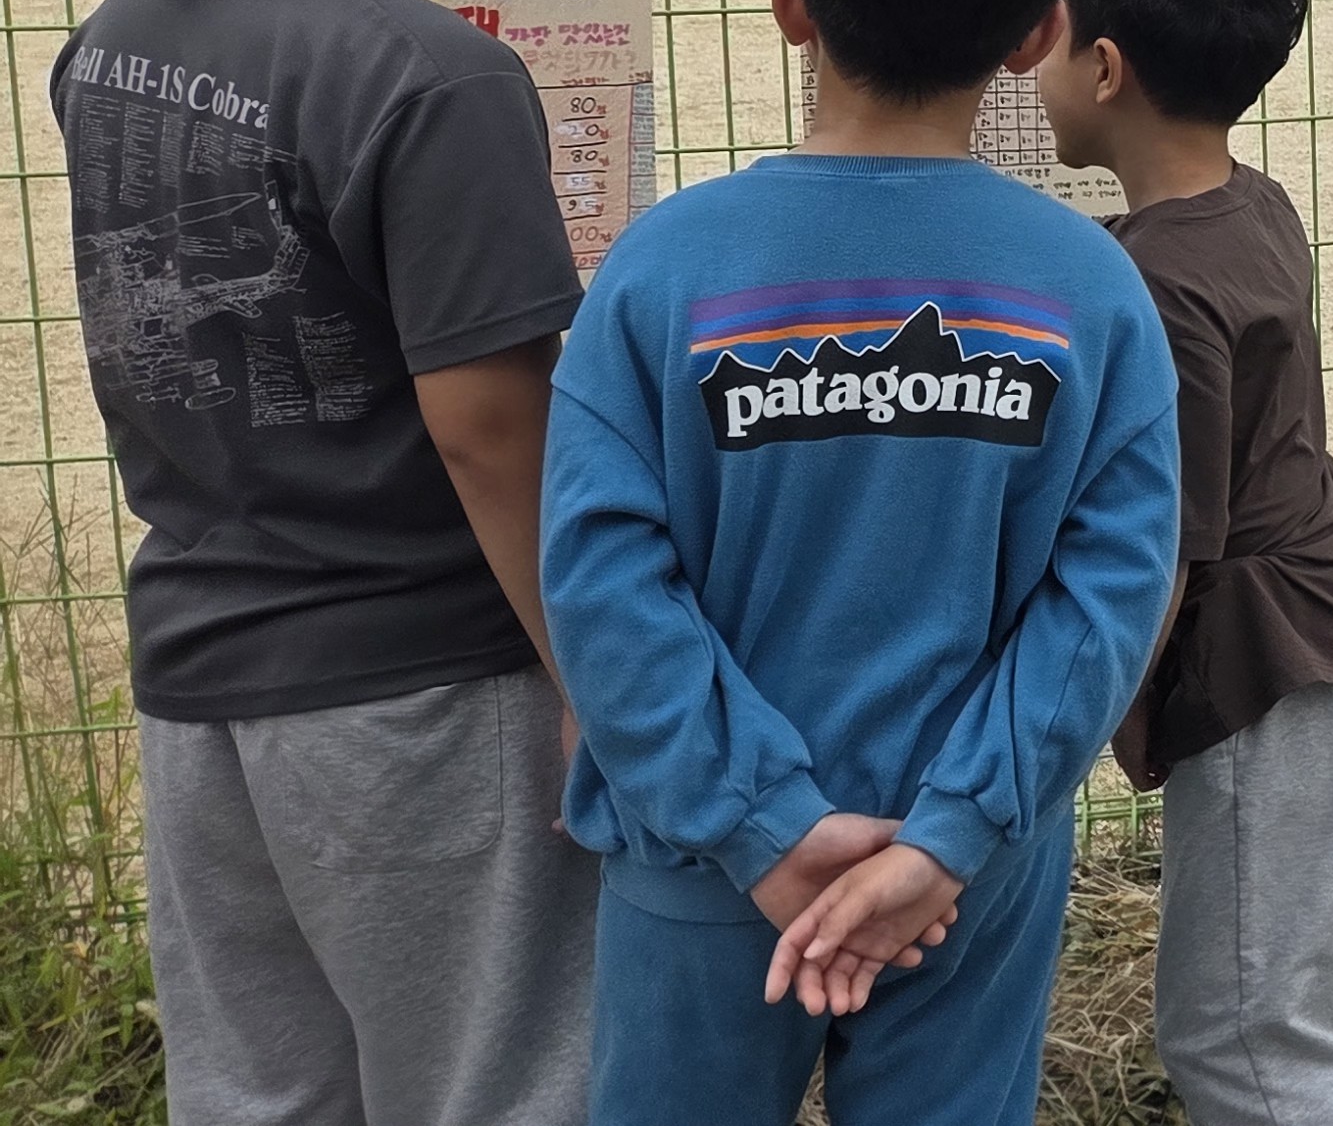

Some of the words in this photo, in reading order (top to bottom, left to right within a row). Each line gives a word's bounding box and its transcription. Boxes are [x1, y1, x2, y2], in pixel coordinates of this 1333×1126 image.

[104, 51, 185, 104] AH-1S
[188, 73, 269, 130] Cobra
[724, 366, 1033, 438] patagonia
